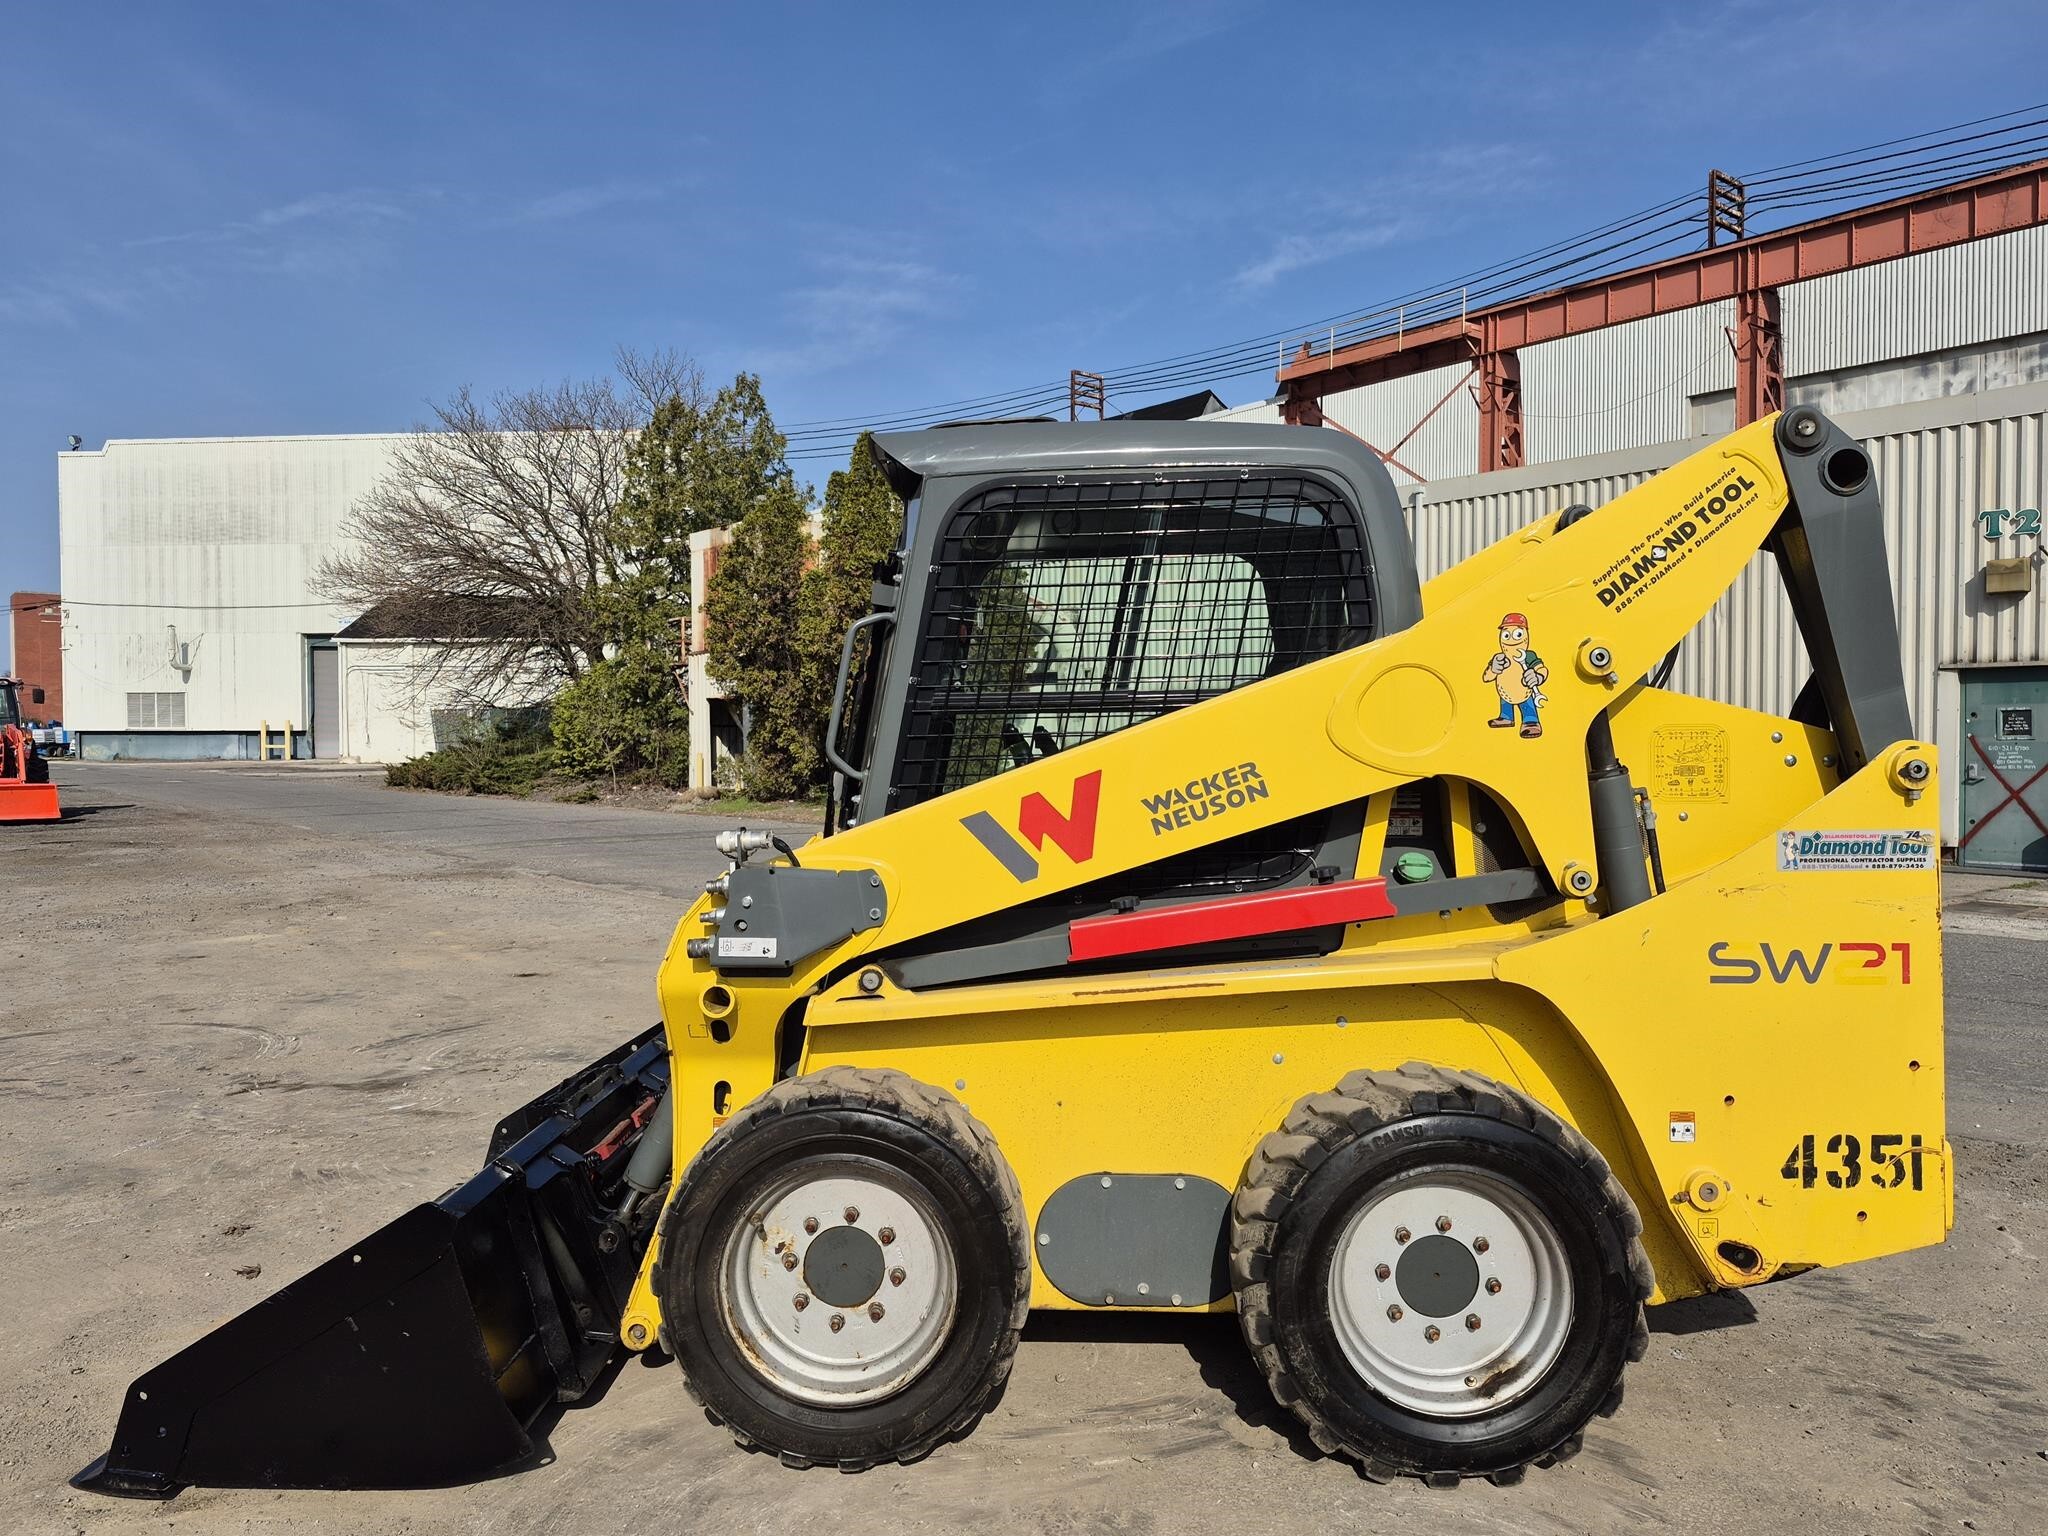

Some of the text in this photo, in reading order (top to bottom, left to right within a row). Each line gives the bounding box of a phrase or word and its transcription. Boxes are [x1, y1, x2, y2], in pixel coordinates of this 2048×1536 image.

[1592, 466, 1737, 587] Supplying The Pros Who Build America
[1694, 475, 1755, 525] TOOL
[1694, 493, 1759, 548] DiamondTool.net
[1140, 761, 1263, 815] WACKER
[1150, 779, 1269, 837] NEUSON
[1800, 832, 1888, 856] Diamond
